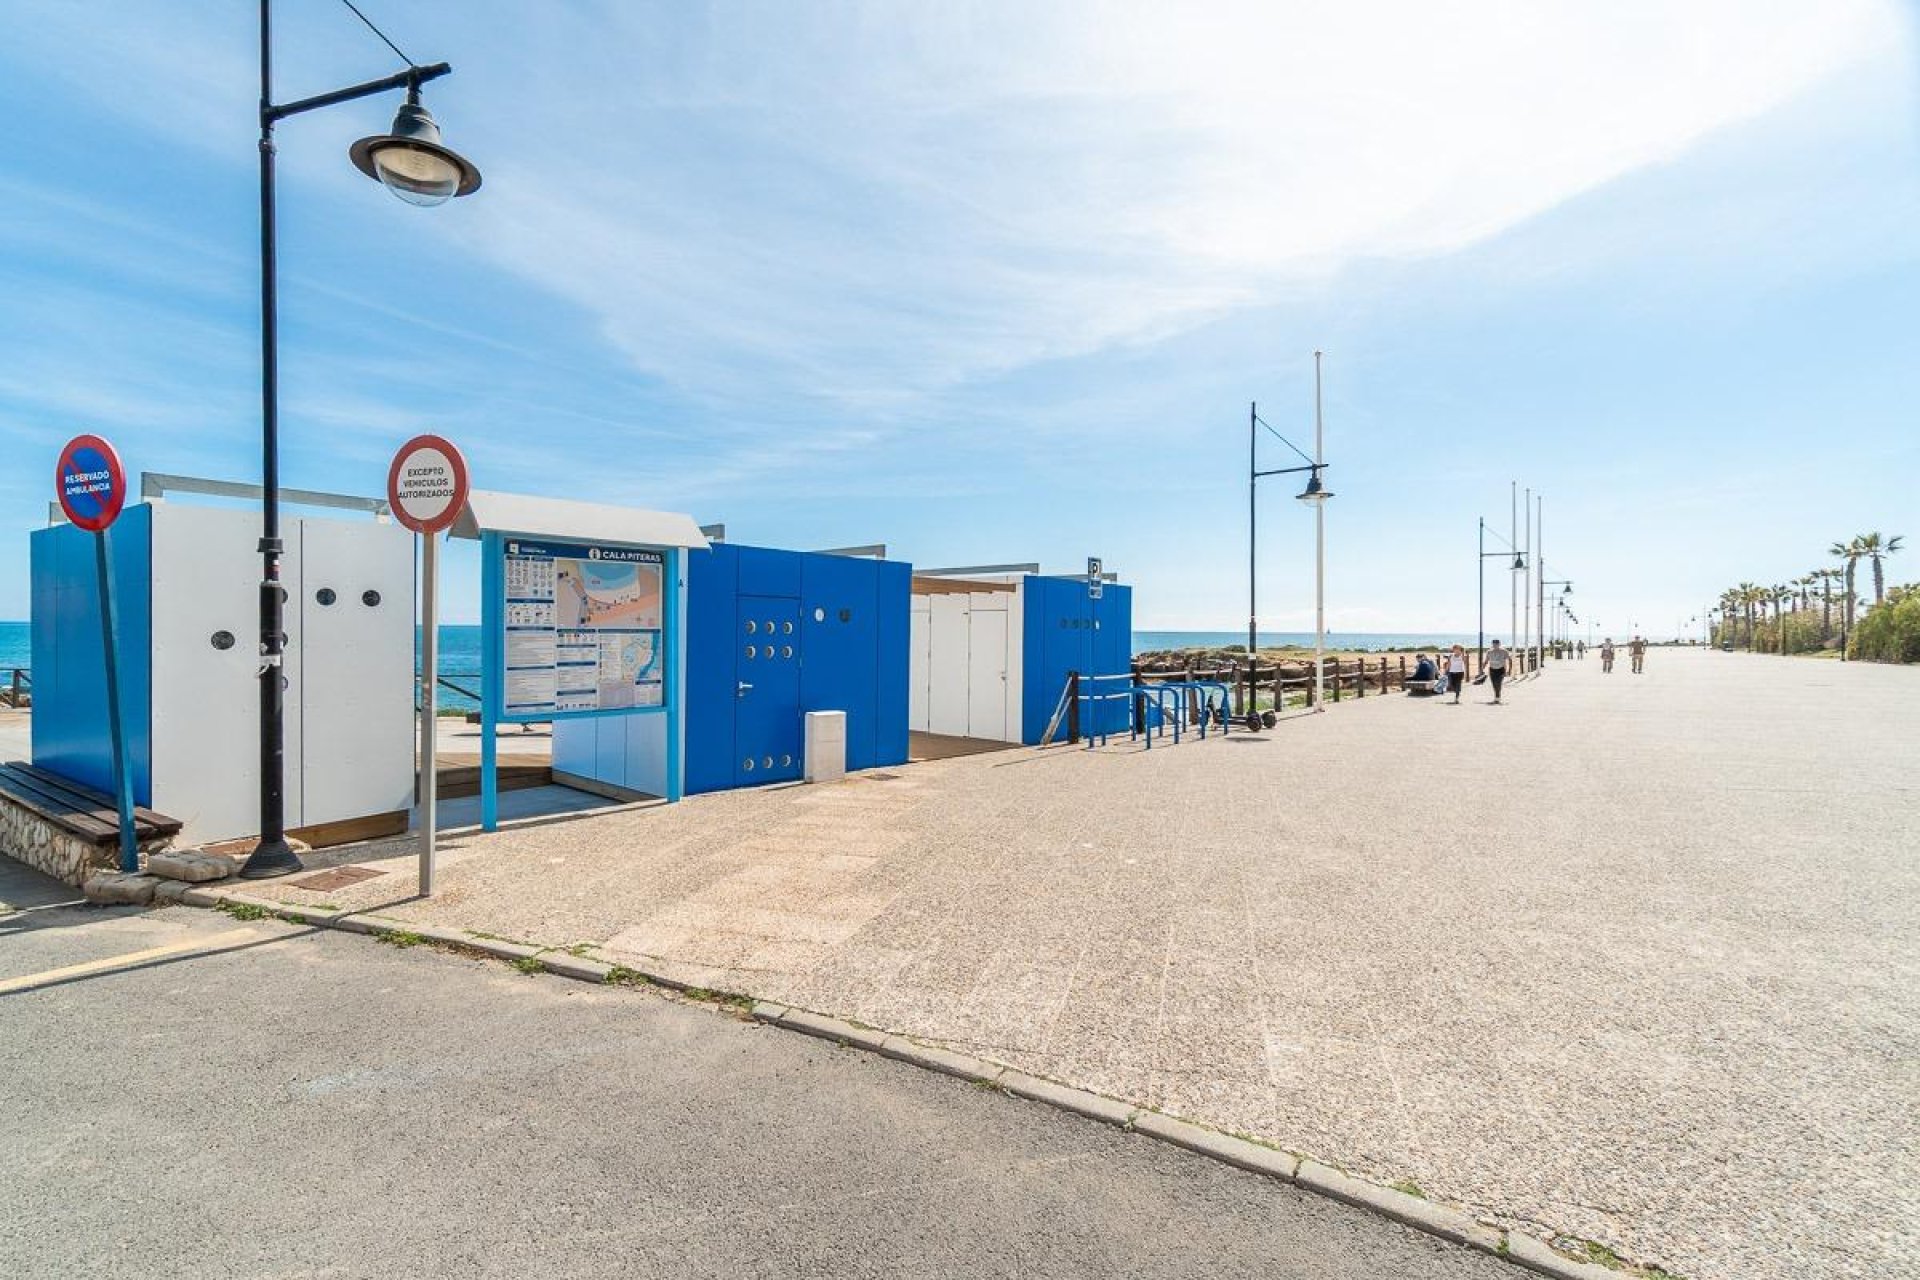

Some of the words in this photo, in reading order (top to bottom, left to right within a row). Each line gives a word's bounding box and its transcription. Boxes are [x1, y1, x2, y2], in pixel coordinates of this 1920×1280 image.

[65, 470, 110, 483] RESERVADO
[407, 467, 444, 477] EXCEPTO
[403, 478, 449, 488] VEHICULOS
[398, 489, 455, 498] AUTORIZADOS
[602, 551, 626, 560] CALA
[627, 553, 661, 562] PITERAS
